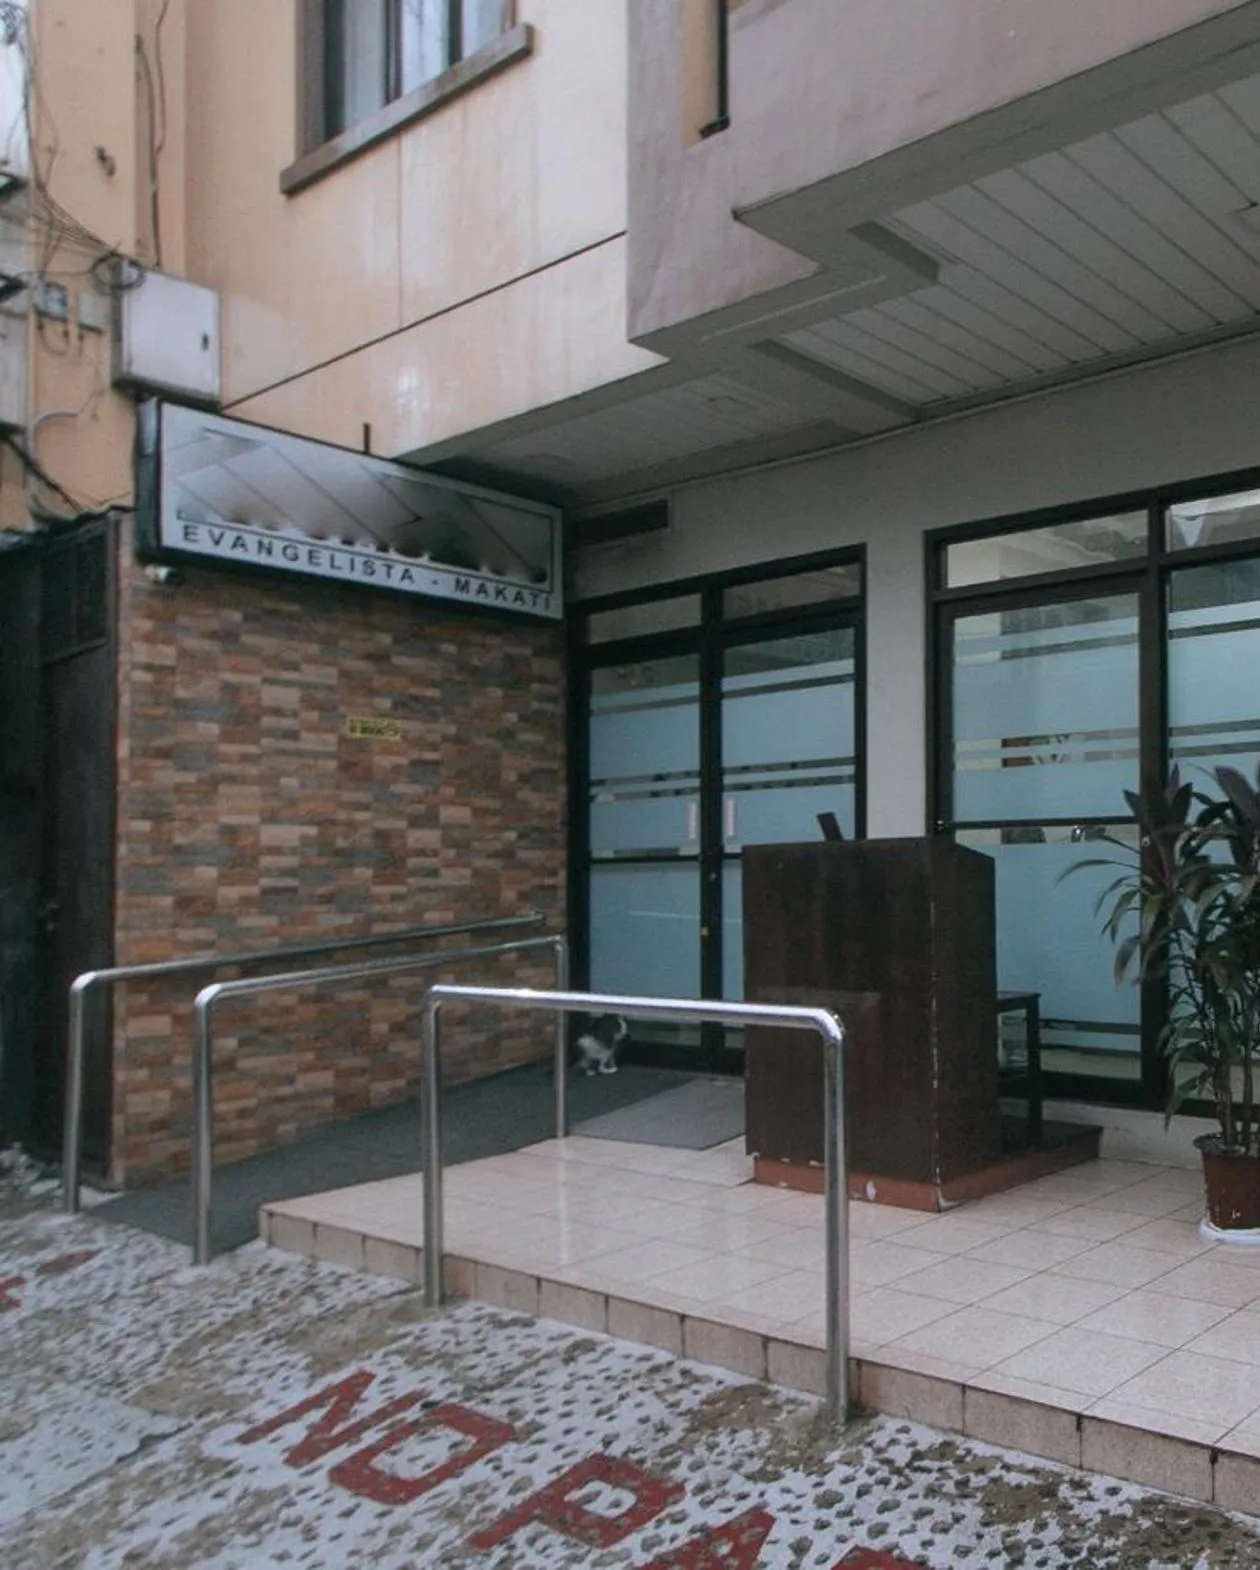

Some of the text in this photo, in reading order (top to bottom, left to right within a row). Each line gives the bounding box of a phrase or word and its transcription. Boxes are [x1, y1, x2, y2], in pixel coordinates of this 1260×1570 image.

[182, 523, 415, 585] EVANGELISTA
[454, 576, 551, 610] MAKATI
[234, 1370, 516, 1506] NO
